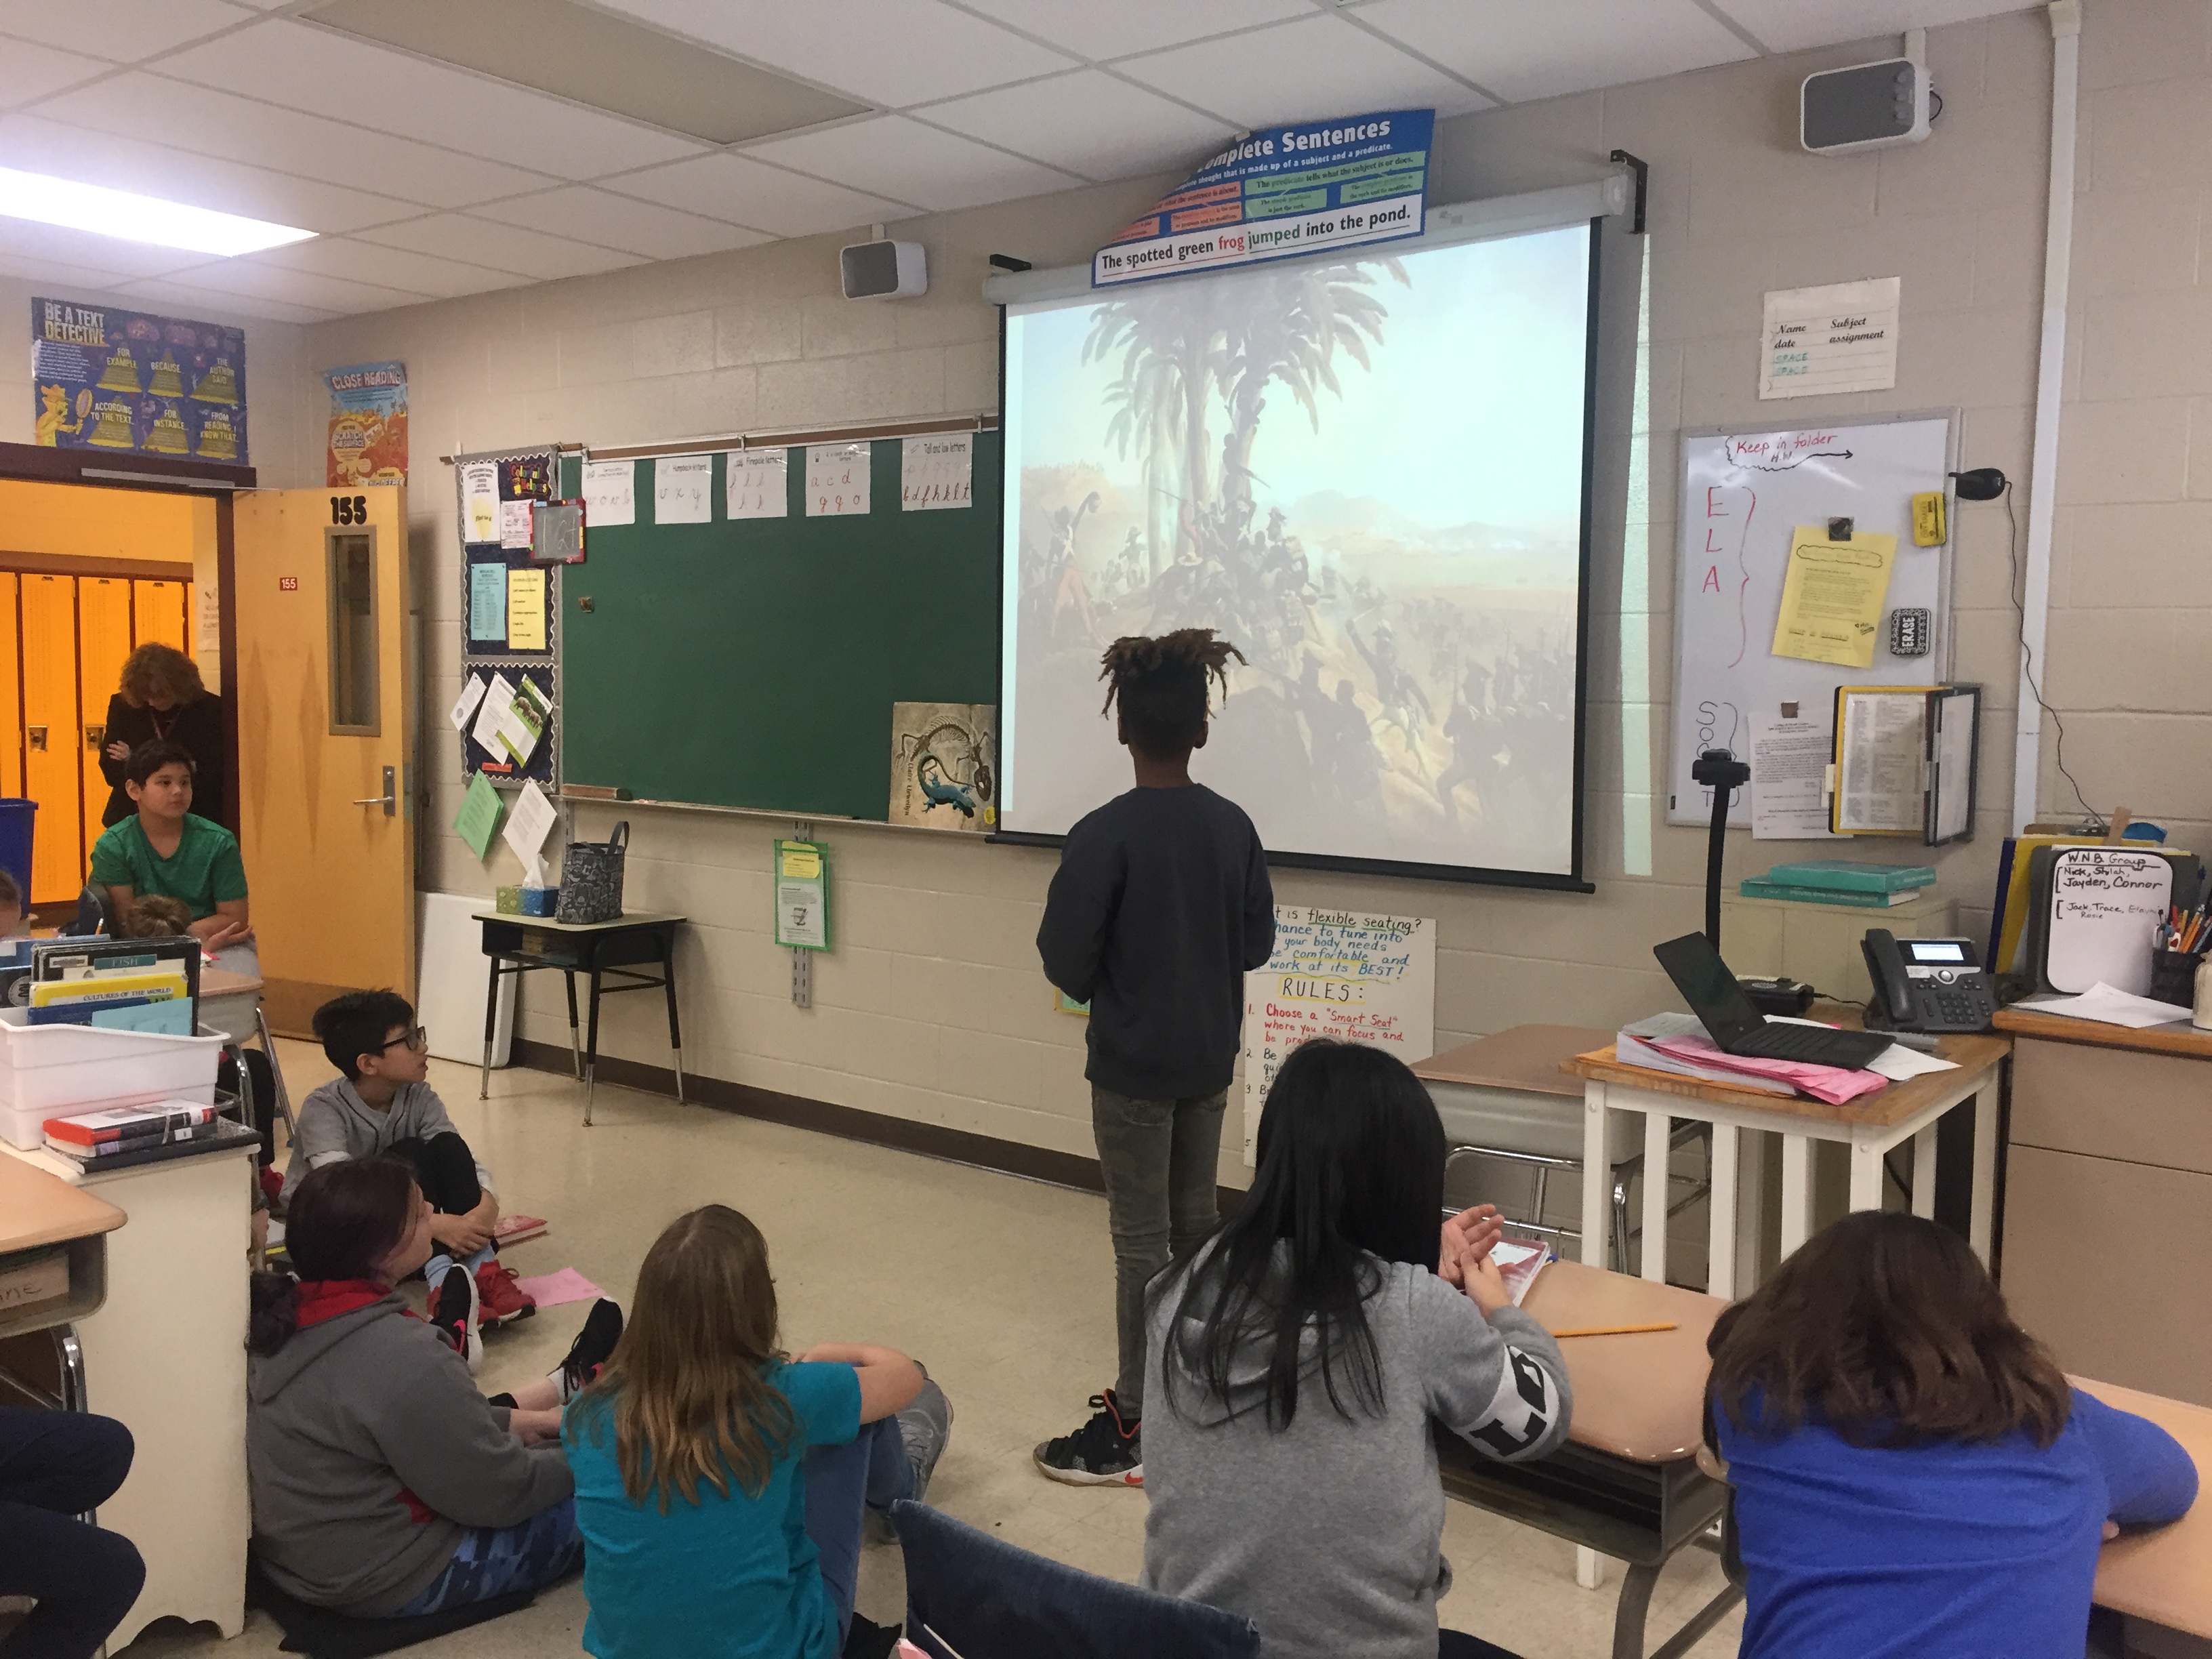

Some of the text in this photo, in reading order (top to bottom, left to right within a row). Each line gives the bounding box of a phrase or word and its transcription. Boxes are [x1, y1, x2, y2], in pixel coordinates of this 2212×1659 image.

[1282, 121, 1391, 152] Sentences
[1224, 169, 1238, 178] that
[1239, 167, 1246, 175] is
[1248, 164, 1268, 173] made
[1270, 163, 1280, 171] up
[1283, 159, 1293, 169] of
[1301, 155, 1330, 167] subject
[1331, 151, 1347, 161] and
[1355, 143, 1393, 157] predicate.
[1256, 180, 1271, 189] The
[1305, 172, 1321, 182] tells
[1322, 169, 1339, 180] what
[1340, 166, 1351, 175] the
[1352, 163, 1377, 175] subject
[1378, 161, 1384, 169] is
[1187, 191, 1212, 201] sentence
[1219, 186, 1239, 197] about.
[1102, 204, 1411, 269] The spotted green frog jumped into the pond.
[44, 302, 105, 328] BE A TEXT
[45, 320, 105, 344] DETECTIVE
[1776, 317, 1866, 335] Name Subject
[1774, 329, 1884, 349] date assignment
[117, 347, 130, 358] FOR
[1775, 352, 1808, 363] SPACE
[331, 370, 401, 390] CLOSE READING
[94, 403, 133, 415] ACCORDING
[164, 409, 177, 419] FOR
[210, 411, 229, 422] FROM
[91, 412, 100, 421] TO
[101, 412, 115, 422] THE
[200, 431, 220, 441] KNOW
[1736, 431, 1838, 456] Keep in folder
[949, 441, 966, 453] letters
[746, 457, 764, 468] Firepole
[827, 476, 834, 486] c
[842, 469, 851, 484] d
[912, 485, 920, 501] d
[921, 485, 930, 508] f
[932, 484, 940, 501] h
[962, 483, 970, 500] t
[330, 495, 367, 525] 155
[281, 578, 296, 589] 155
[1902, 615, 1915, 647] ERASE
[2109, 853, 2146, 867] Group
[2064, 867, 2091, 877] Nick,
[2063, 876, 2163, 890] Jayden, Connor
[1288, 909, 1298, 920] is
[1307, 909, 1356, 926] flexible
[1275, 920, 1404, 943] hance to tune into
[1284, 938, 1308, 951] your
[1313, 936, 1340, 952] body
[1348, 939, 1387, 951] needs
[111, 958, 138, 966] FISH
[1292, 949, 1369, 964] comfortable
[1381, 954, 1410, 966] and
[1269, 960, 1300, 971] work
[1308, 962, 1323, 972] at
[1330, 962, 1349, 972] its
[83, 992, 119, 1001] CULTURES
[146, 987, 172, 996] WORLD
[1248, 1004, 1255, 1015] 1.
[1266, 1003, 1303, 1019] Choose
[1310, 1012, 1318, 1021] a
[1264, 1021, 1404, 1042] where you can focus and
[1265, 1031, 1276, 1042] be
[1263, 1048, 1277, 1060] Be
[1246, 1084, 1251, 1094] 3
